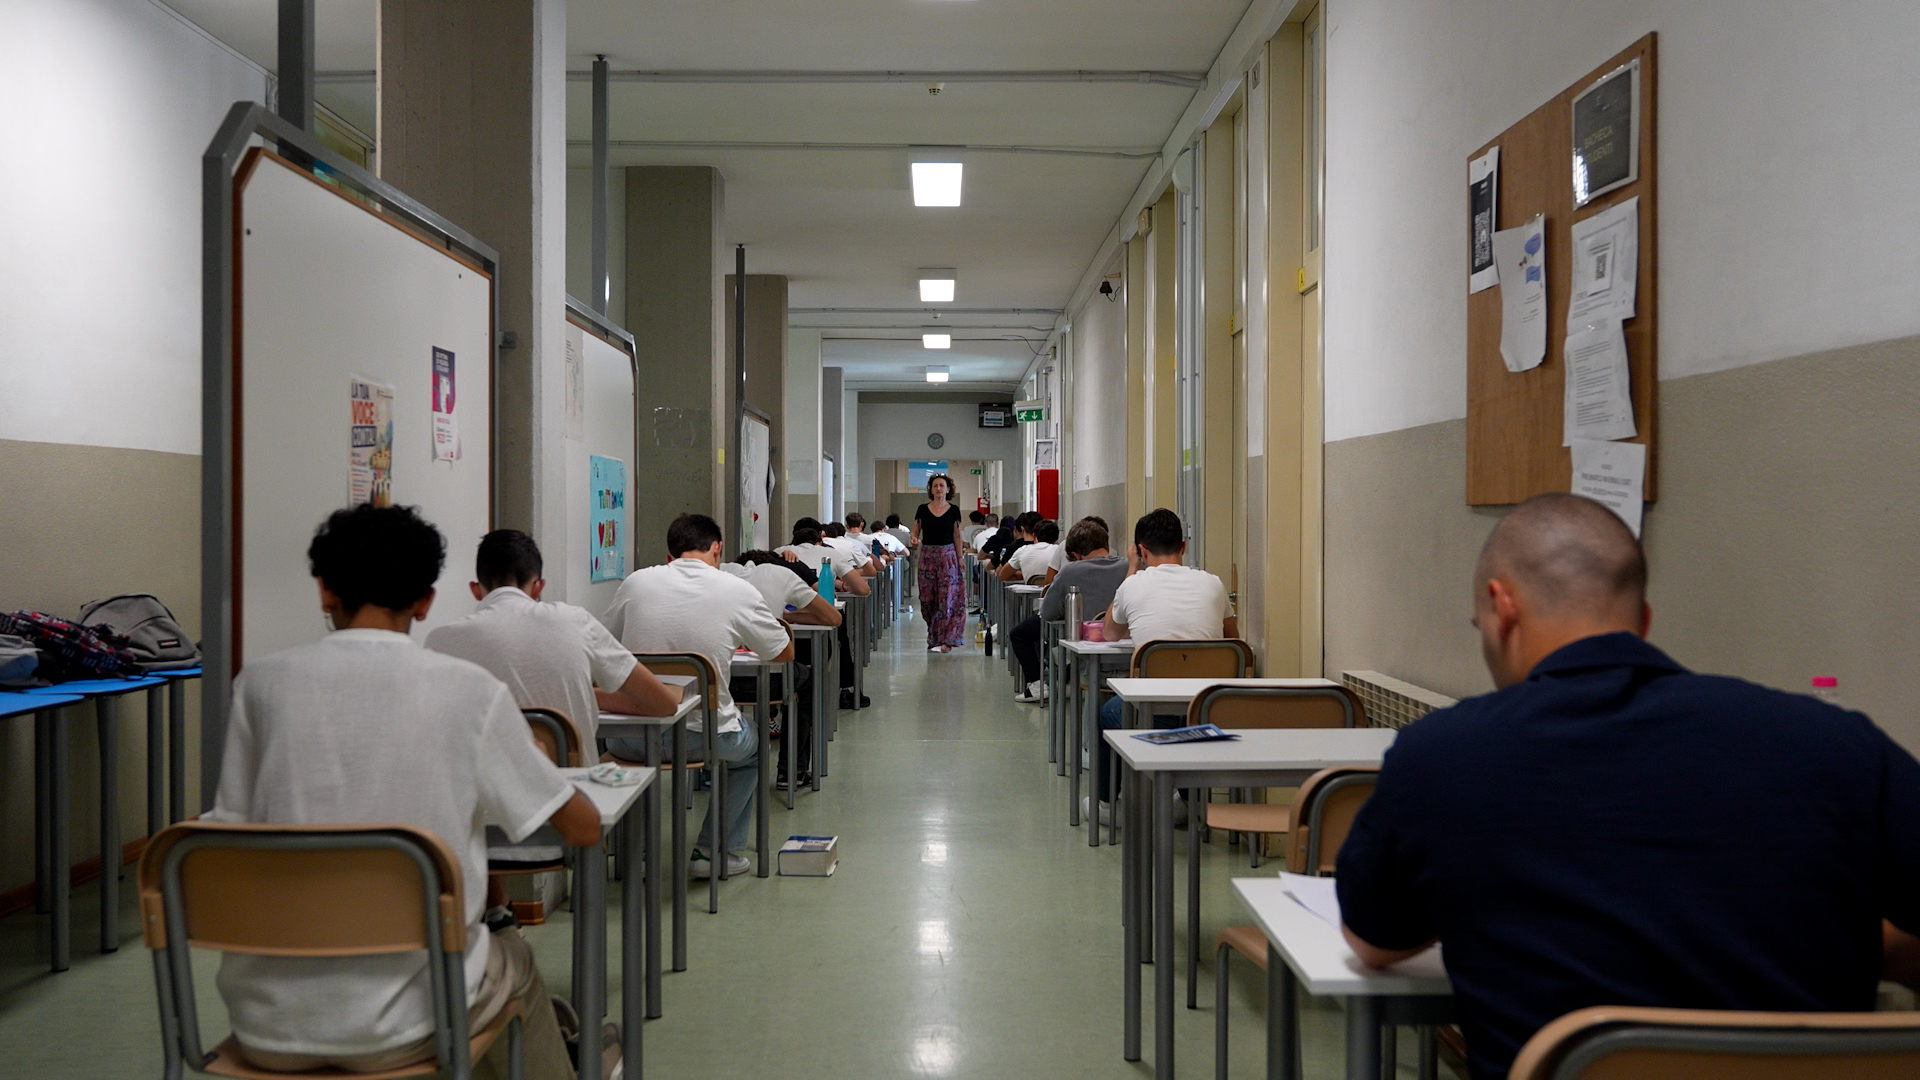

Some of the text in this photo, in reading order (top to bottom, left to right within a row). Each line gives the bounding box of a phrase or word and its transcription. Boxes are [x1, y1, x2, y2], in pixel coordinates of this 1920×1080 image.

[351, 383, 358, 398] LA
[359, 384, 369, 399] TUA
[352, 400, 374, 424] VOCE
